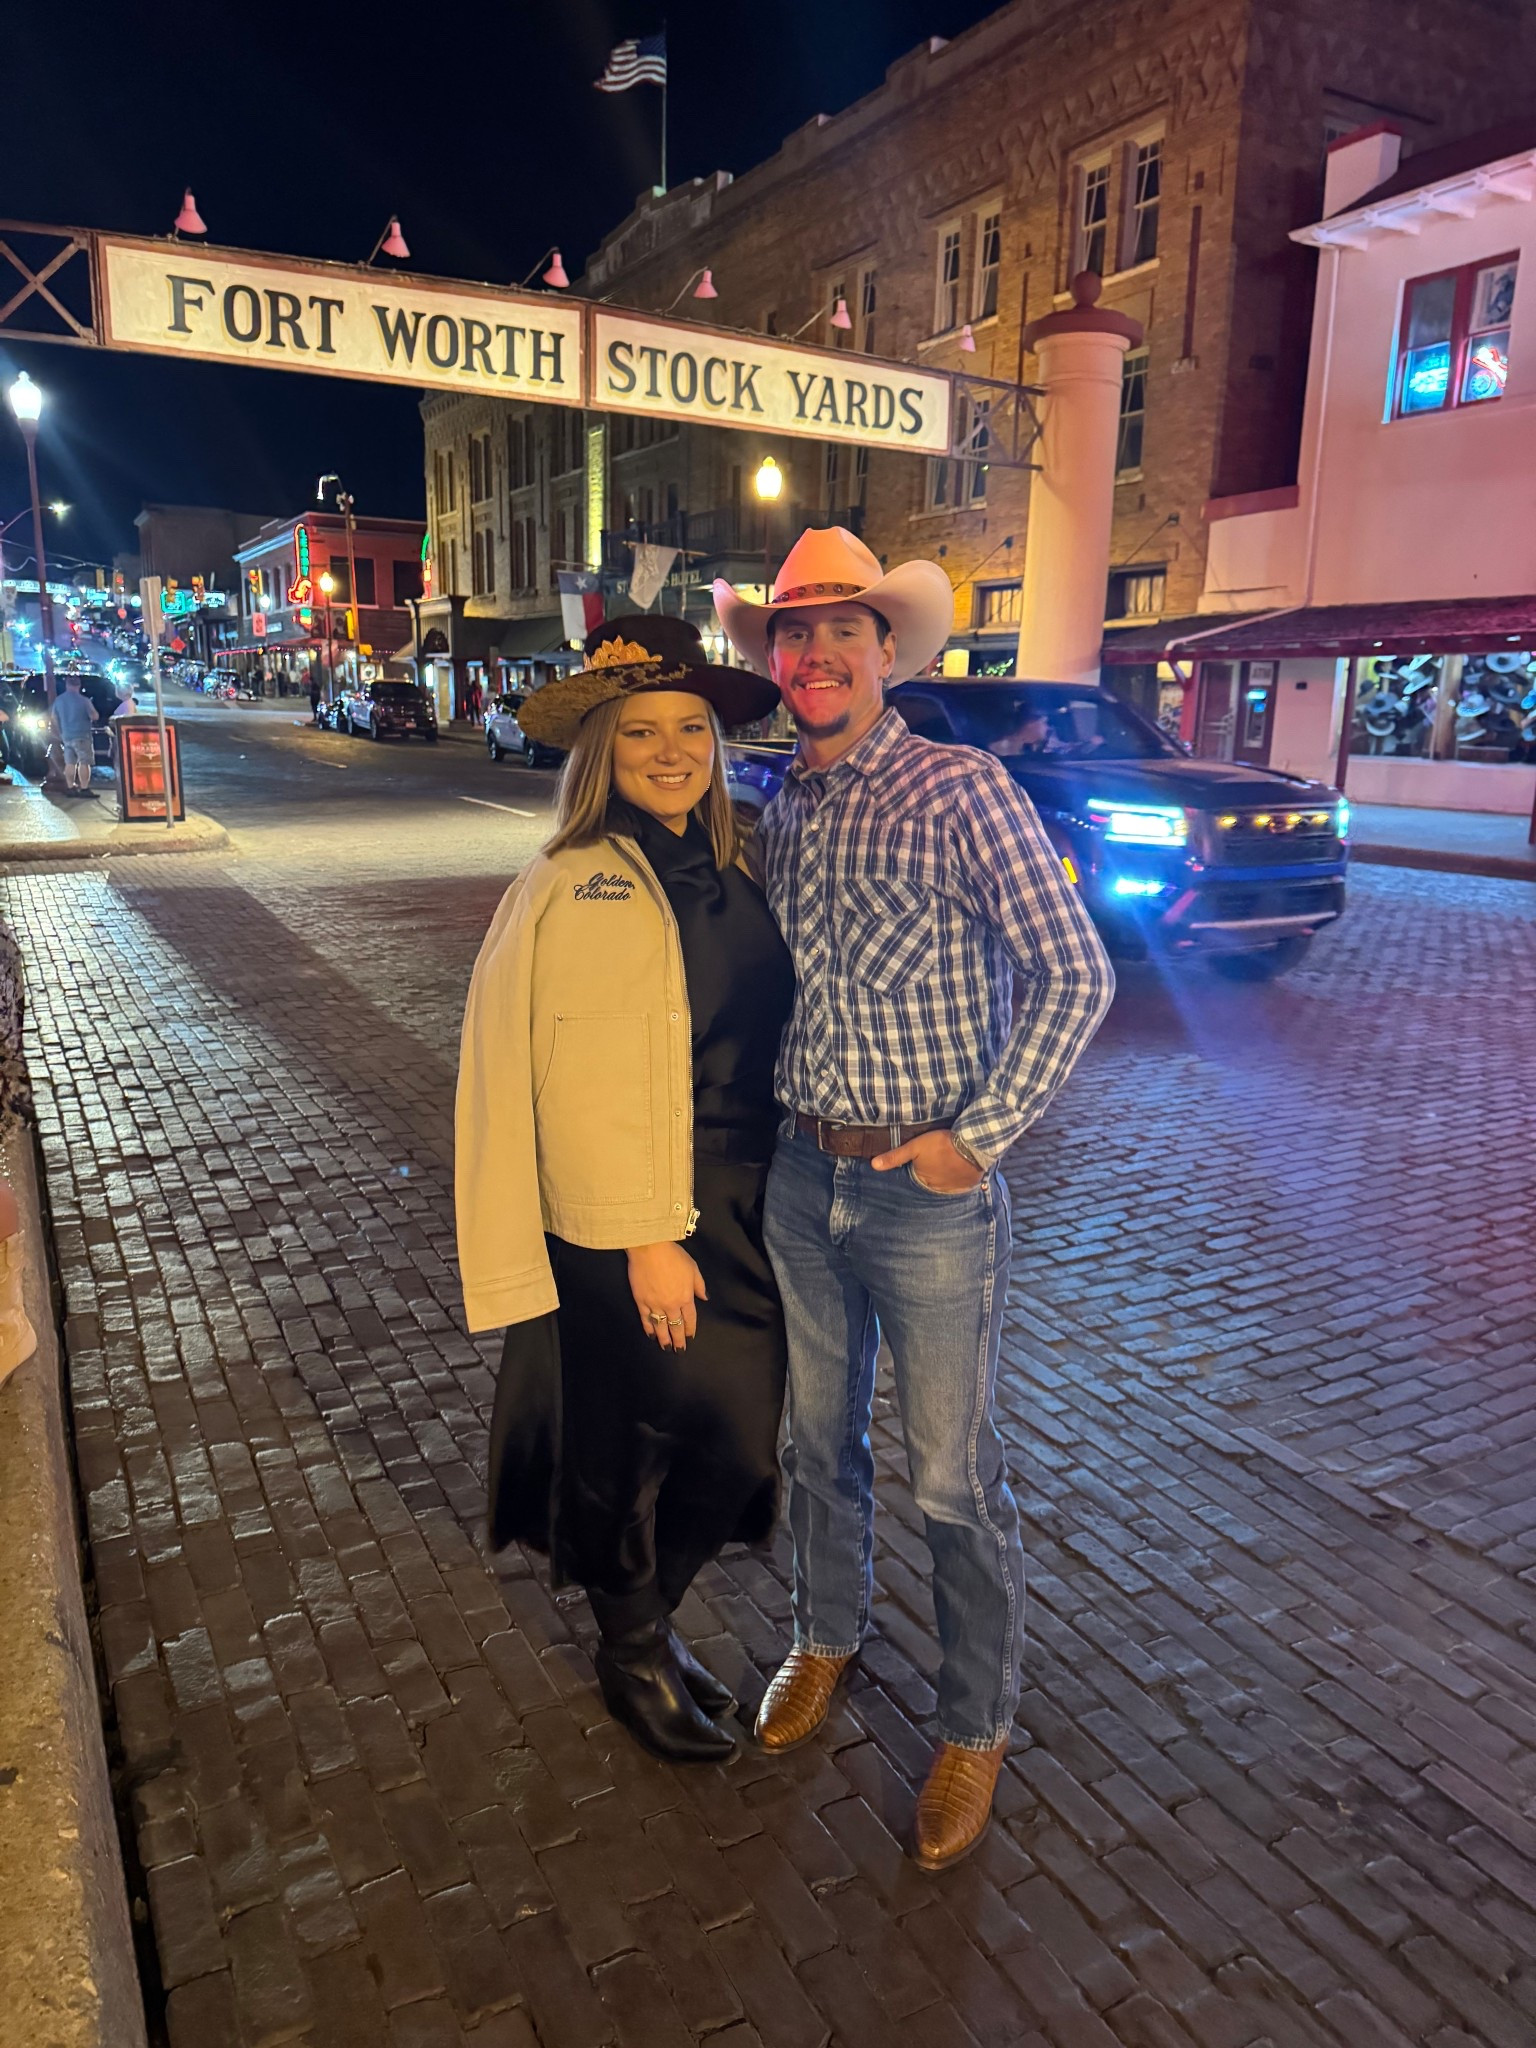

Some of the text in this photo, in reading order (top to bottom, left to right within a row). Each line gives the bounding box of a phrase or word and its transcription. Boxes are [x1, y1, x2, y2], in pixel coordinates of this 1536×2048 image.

[166, 274, 566, 384] FORT WORTH
[607, 340, 924, 435] STOCK YARDS
[671, 570, 702, 587] HOTEL
[587, 872, 635, 890] Golden,
[573, 884, 631, 901] Colorado
